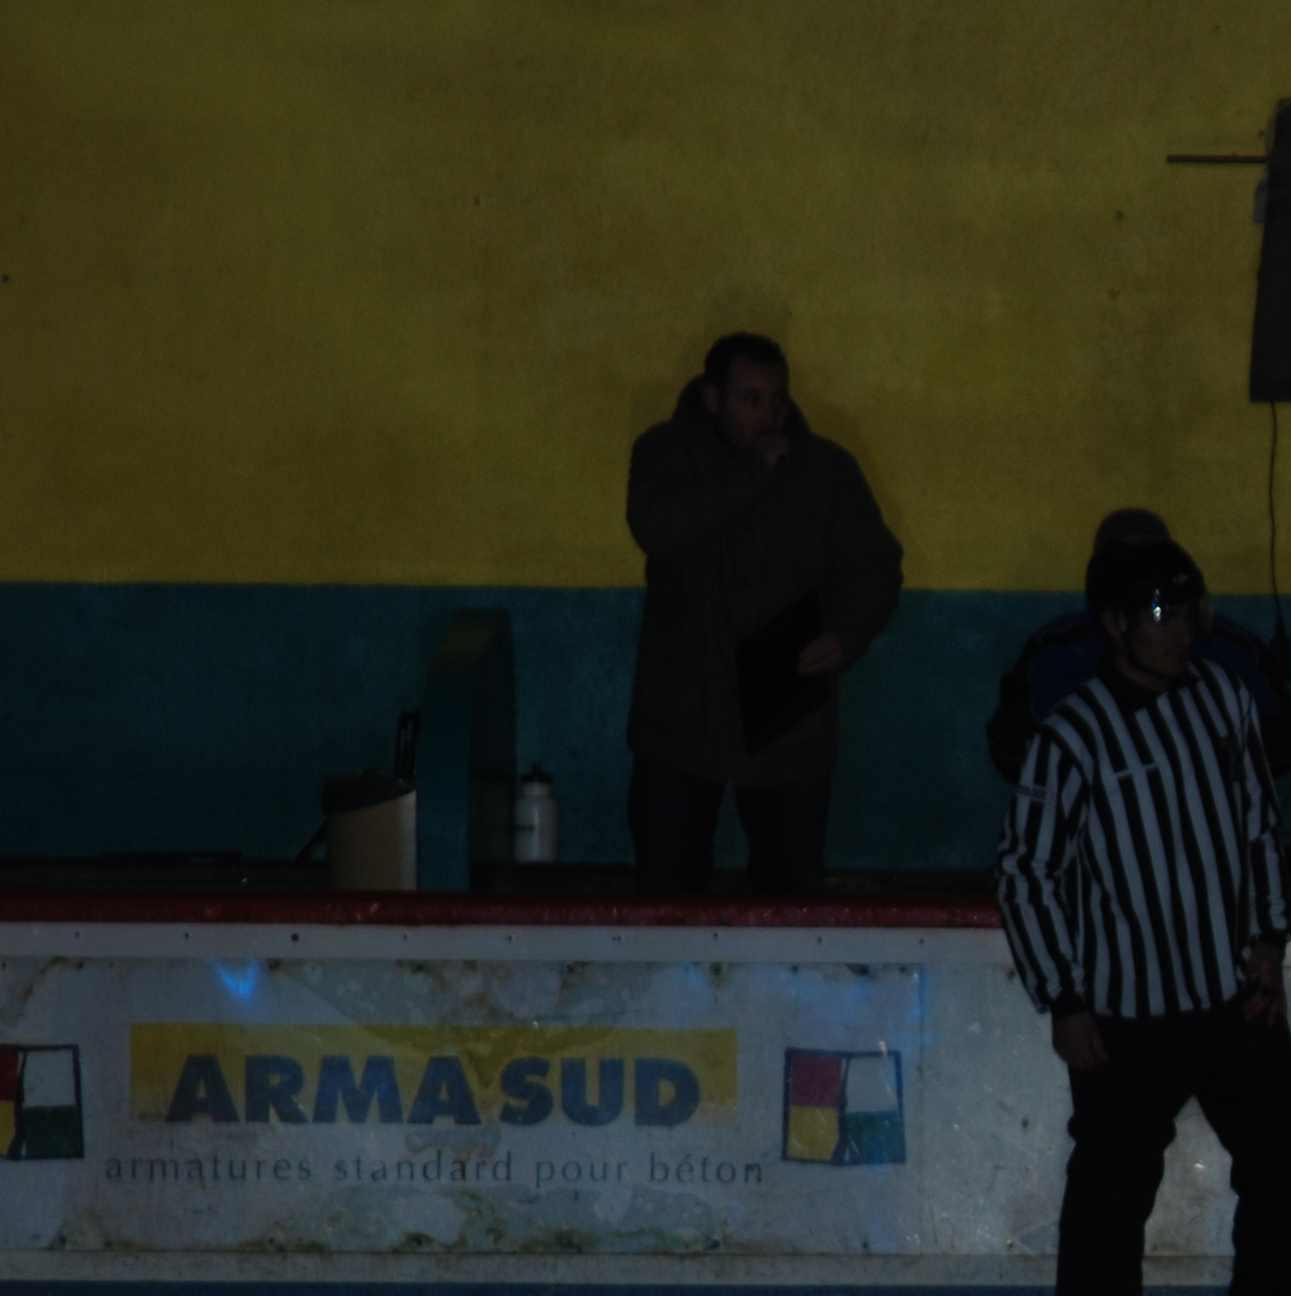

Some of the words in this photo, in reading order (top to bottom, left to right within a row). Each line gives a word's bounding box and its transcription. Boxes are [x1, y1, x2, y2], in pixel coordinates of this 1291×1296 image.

[104, 1152, 312, 1183] armatures
[334, 1150, 513, 1184] standard
[535, 1158, 629, 1190] pour
[650, 1150, 764, 1185] béton
